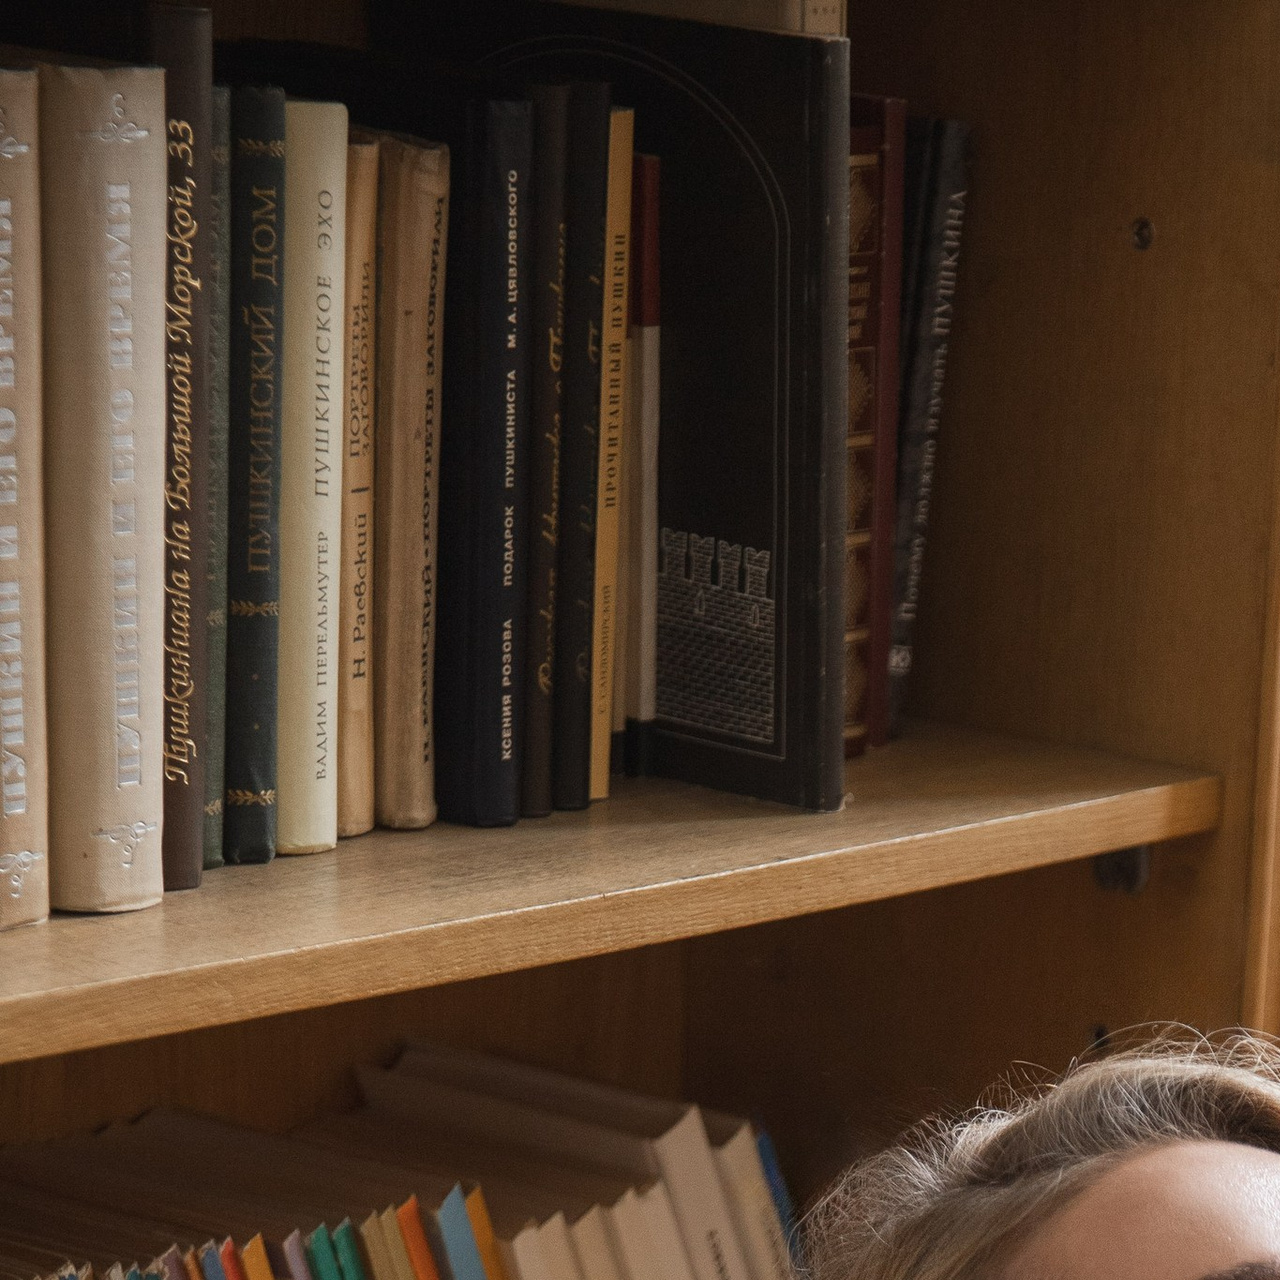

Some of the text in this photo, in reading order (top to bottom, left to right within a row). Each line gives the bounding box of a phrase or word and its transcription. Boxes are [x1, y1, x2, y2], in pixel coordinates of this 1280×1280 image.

[242, 184, 279, 574] ПУШКИНСКИЙ ДОМ
[349, 303, 361, 459] ПОРТРЕТЫ
[359, 261, 371, 458] ЗАГОВОРИЛИ
[604, 341, 622, 509] ПРОЧИТАННЫЙ
[611, 233, 626, 330] ПУШКИН
[898, 536, 926, 621] Почему
[930, 189, 969, 337] ПУШКИНА
[104, 180, 142, 790] ПУШКИН И ЕГО ВРЕМЯ
[162, 119, 202, 786] Пушкиниана на Большой Морской, 33
[314, 189, 333, 781] ВАДИМ ПЕРЕЛЬМУТЕР ПУШКИНСКОЕ ЭХО
[350, 512, 369, 681] Н. Раевский
[501, 169, 519, 761] КСЕНИЯ РОЗОВА ПОДАРОК ПУШКИНИСТА М. А. ЦЯВЛОВСКОГО
[0, 580, 26, 818] ПУШКИН
